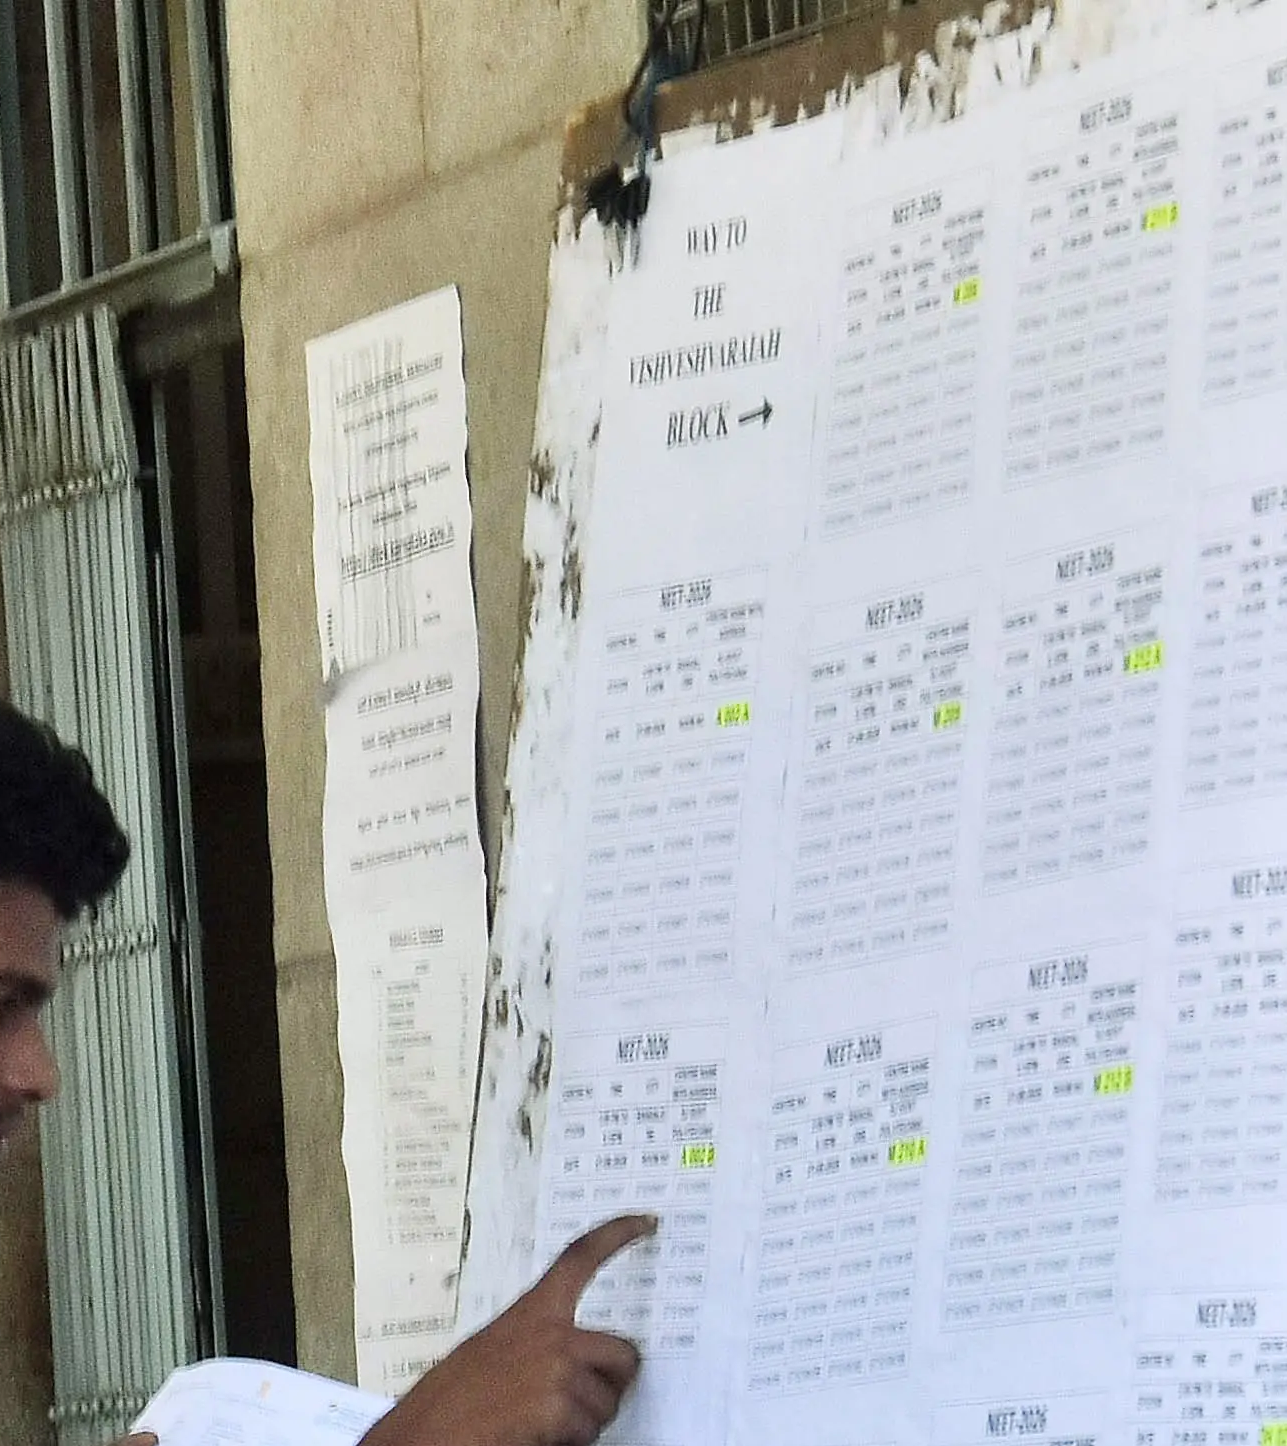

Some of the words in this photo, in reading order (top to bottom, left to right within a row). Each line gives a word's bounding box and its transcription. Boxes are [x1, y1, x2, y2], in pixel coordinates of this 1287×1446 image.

[687, 222, 718, 255] WAY
[726, 216, 747, 250] TO
[692, 282, 726, 319] THE
[666, 401, 730, 449] BLOCK
[865, 593, 924, 630] NEET-2026
[824, 1033, 882, 1069] NEET-2026
[986, 1405, 1048, 1437] NEET-2026
